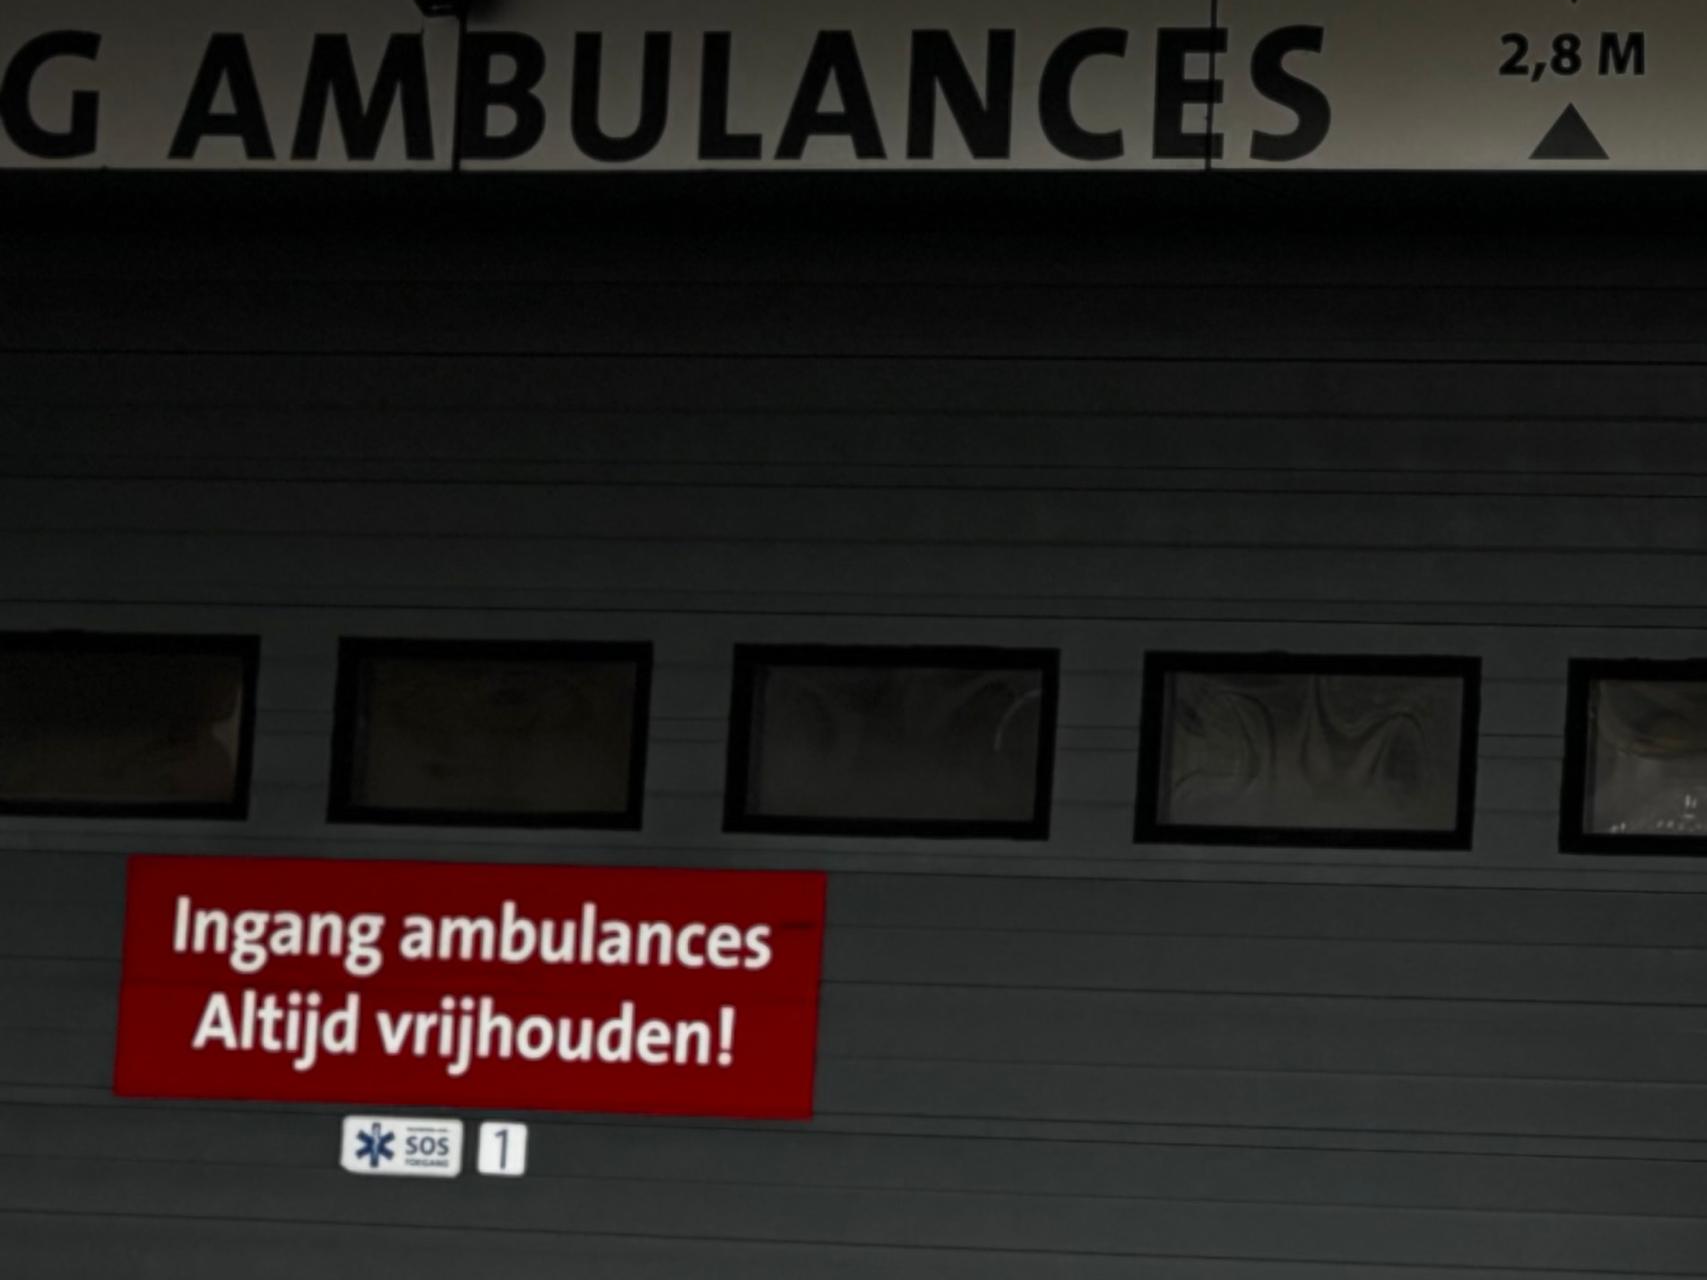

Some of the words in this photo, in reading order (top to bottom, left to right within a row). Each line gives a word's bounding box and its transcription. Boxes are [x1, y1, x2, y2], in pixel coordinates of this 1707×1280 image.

[1500, 34, 1581, 81] 2,8
[1599, 32, 1645, 76] M
[167, 26, 1332, 163] AMBULANCES
[174, 897, 384, 976] Ingang
[400, 903, 771, 970] ambulances
[193, 991, 358, 1071] Altijd
[377, 995, 735, 1076] vrijhouden!
[405, 1136, 450, 1156] SOS
[494, 1128, 509, 1170] 1
